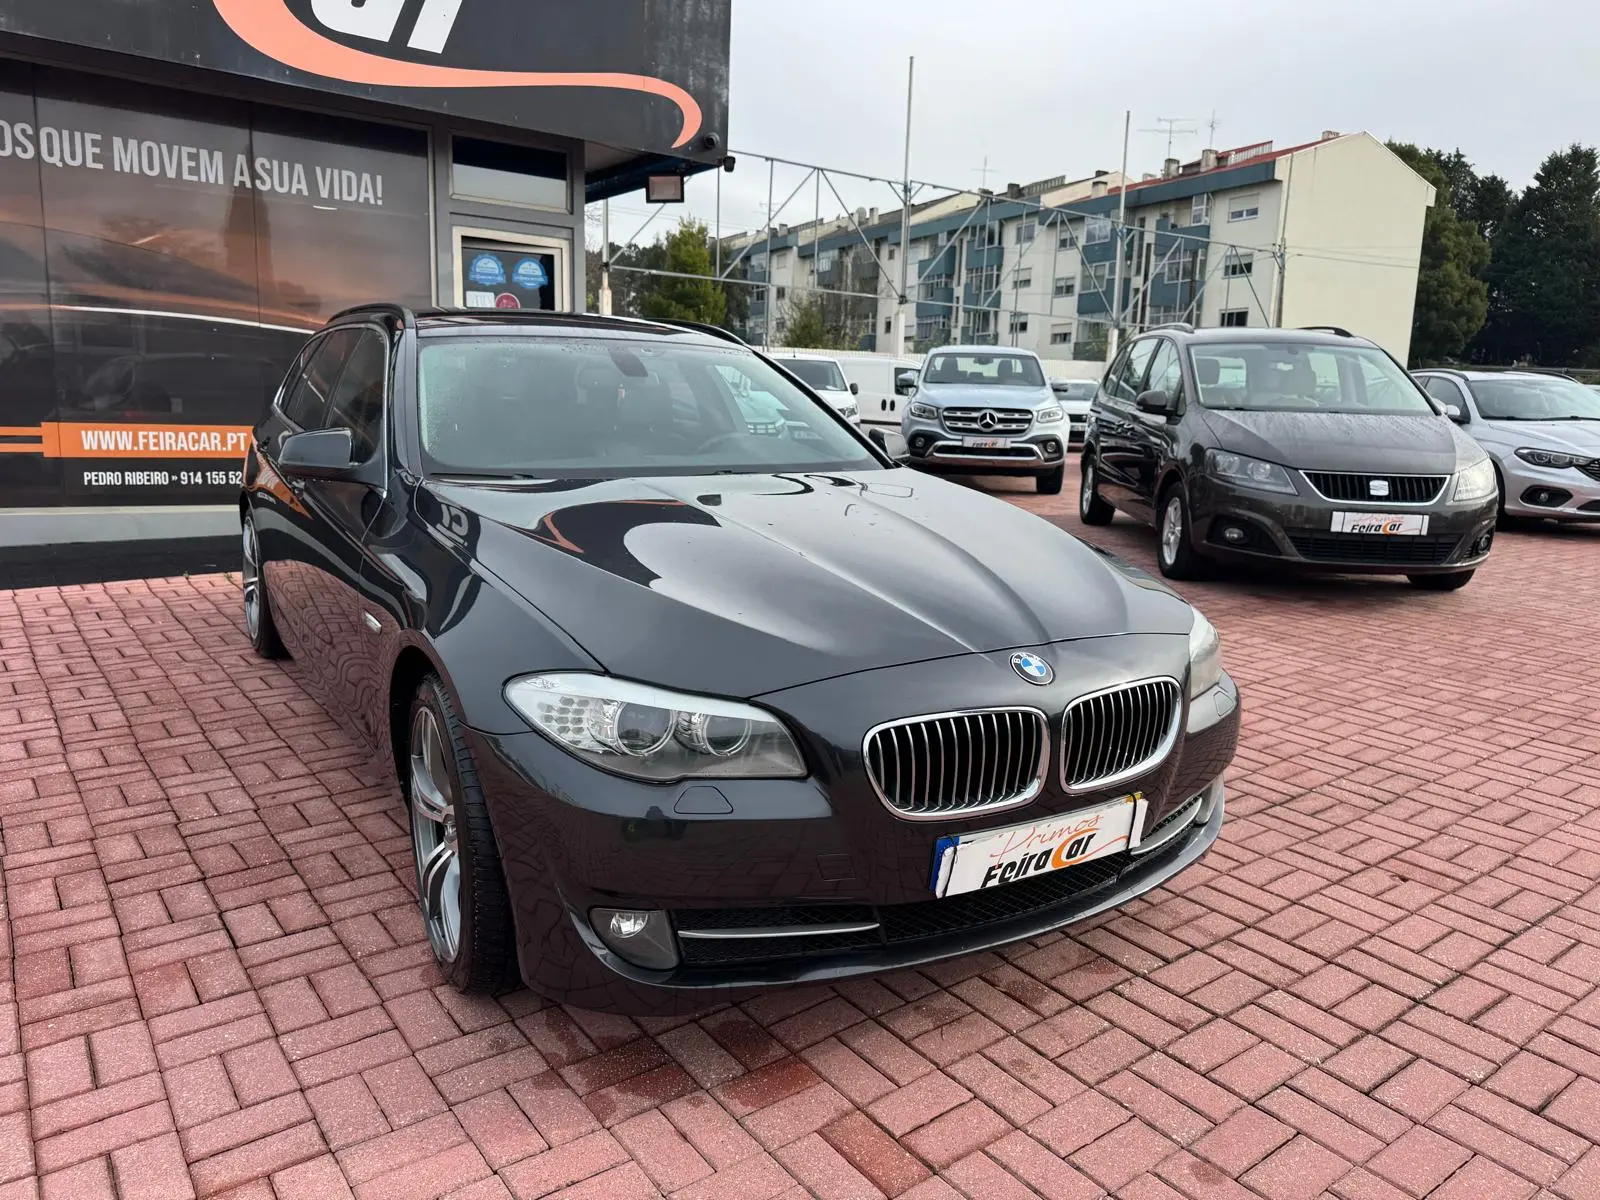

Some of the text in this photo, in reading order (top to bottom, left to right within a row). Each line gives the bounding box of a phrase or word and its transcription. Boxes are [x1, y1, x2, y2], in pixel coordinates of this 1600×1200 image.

[39, 126, 104, 169] QUE
[112, 136, 224, 185] MOVEM
[233, 154, 252, 189] A
[254, 157, 309, 196] SUA
[315, 166, 383, 206] VIDA!
[81, 430, 247, 451] WWW.FEIRACAR.PT
[83, 471, 122, 486] PEDRO
[125, 471, 169, 485] RIBEIRO
[180, 471, 203, 485] 914
[206, 471, 226, 485] 155
[980, 827, 1100, 889] FeiraCar
